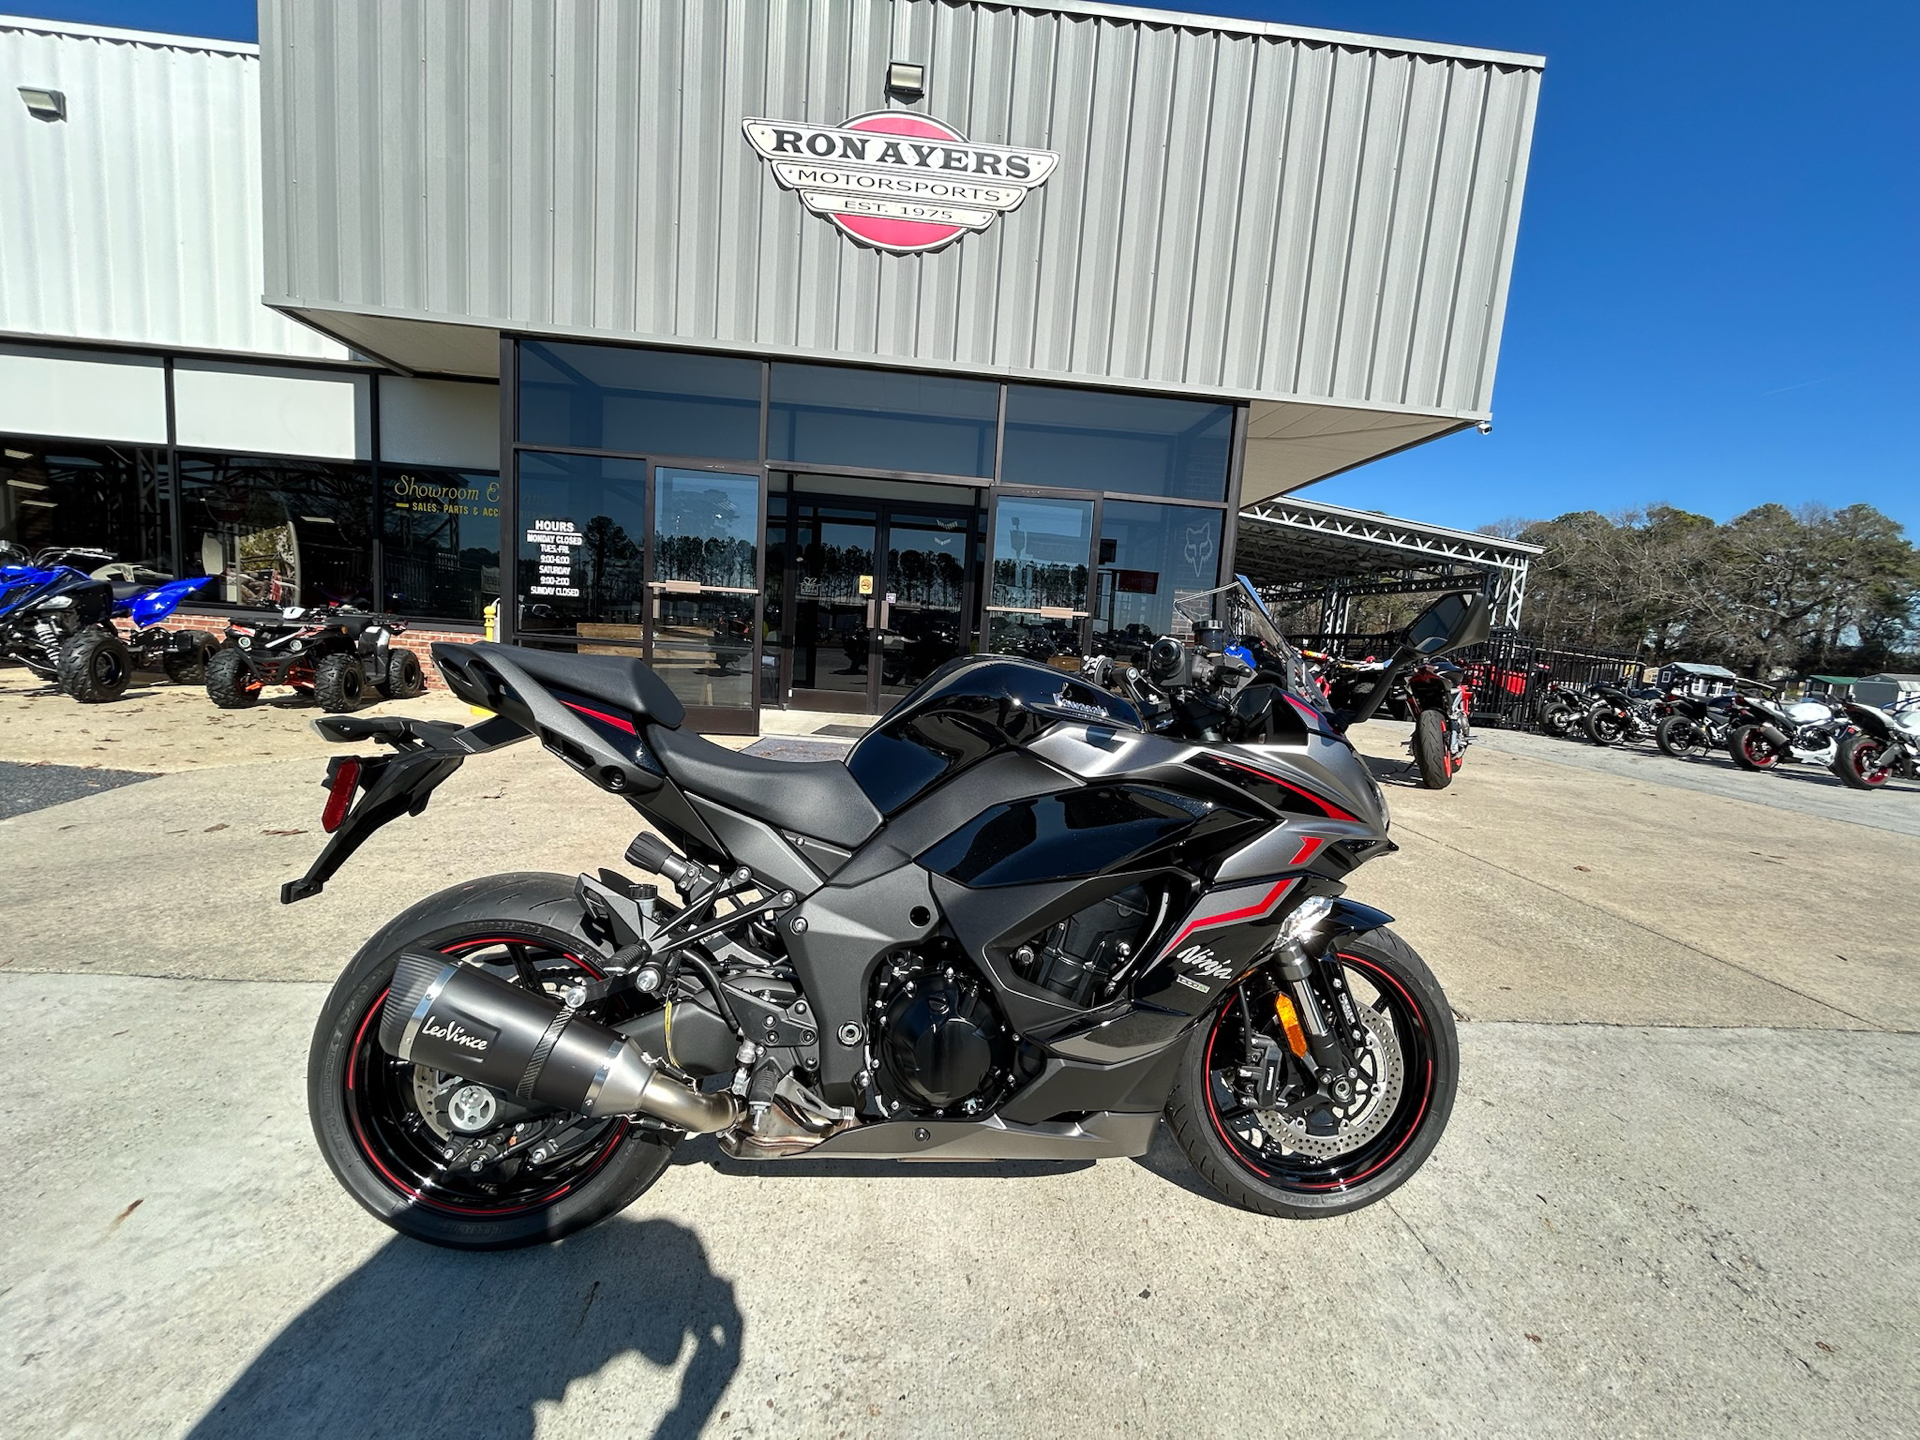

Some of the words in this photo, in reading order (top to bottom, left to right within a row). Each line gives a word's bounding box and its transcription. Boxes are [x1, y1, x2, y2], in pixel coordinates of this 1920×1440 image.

[771, 128, 870, 161] RON
[876, 141, 1031, 179] AYERS
[798, 169, 1001, 202] MOTORSPORTS
[844, 200, 889, 213] EST.
[901, 206, 953, 220] 1975
[394, 475, 479, 500] Showroom
[443, 504, 469, 515] PARTS
[535, 520, 575, 532] HOURS
[527, 534, 555, 543] MONDAY
[556, 535, 582, 546] CLOSED
[539, 565, 571, 575] SATURDAY
[530, 586, 555, 595] SUNDAY
[555, 587, 579, 597] CLOSED
[1176, 944, 1233, 979] Ninja
[421, 1015, 488, 1050] LeoVince
